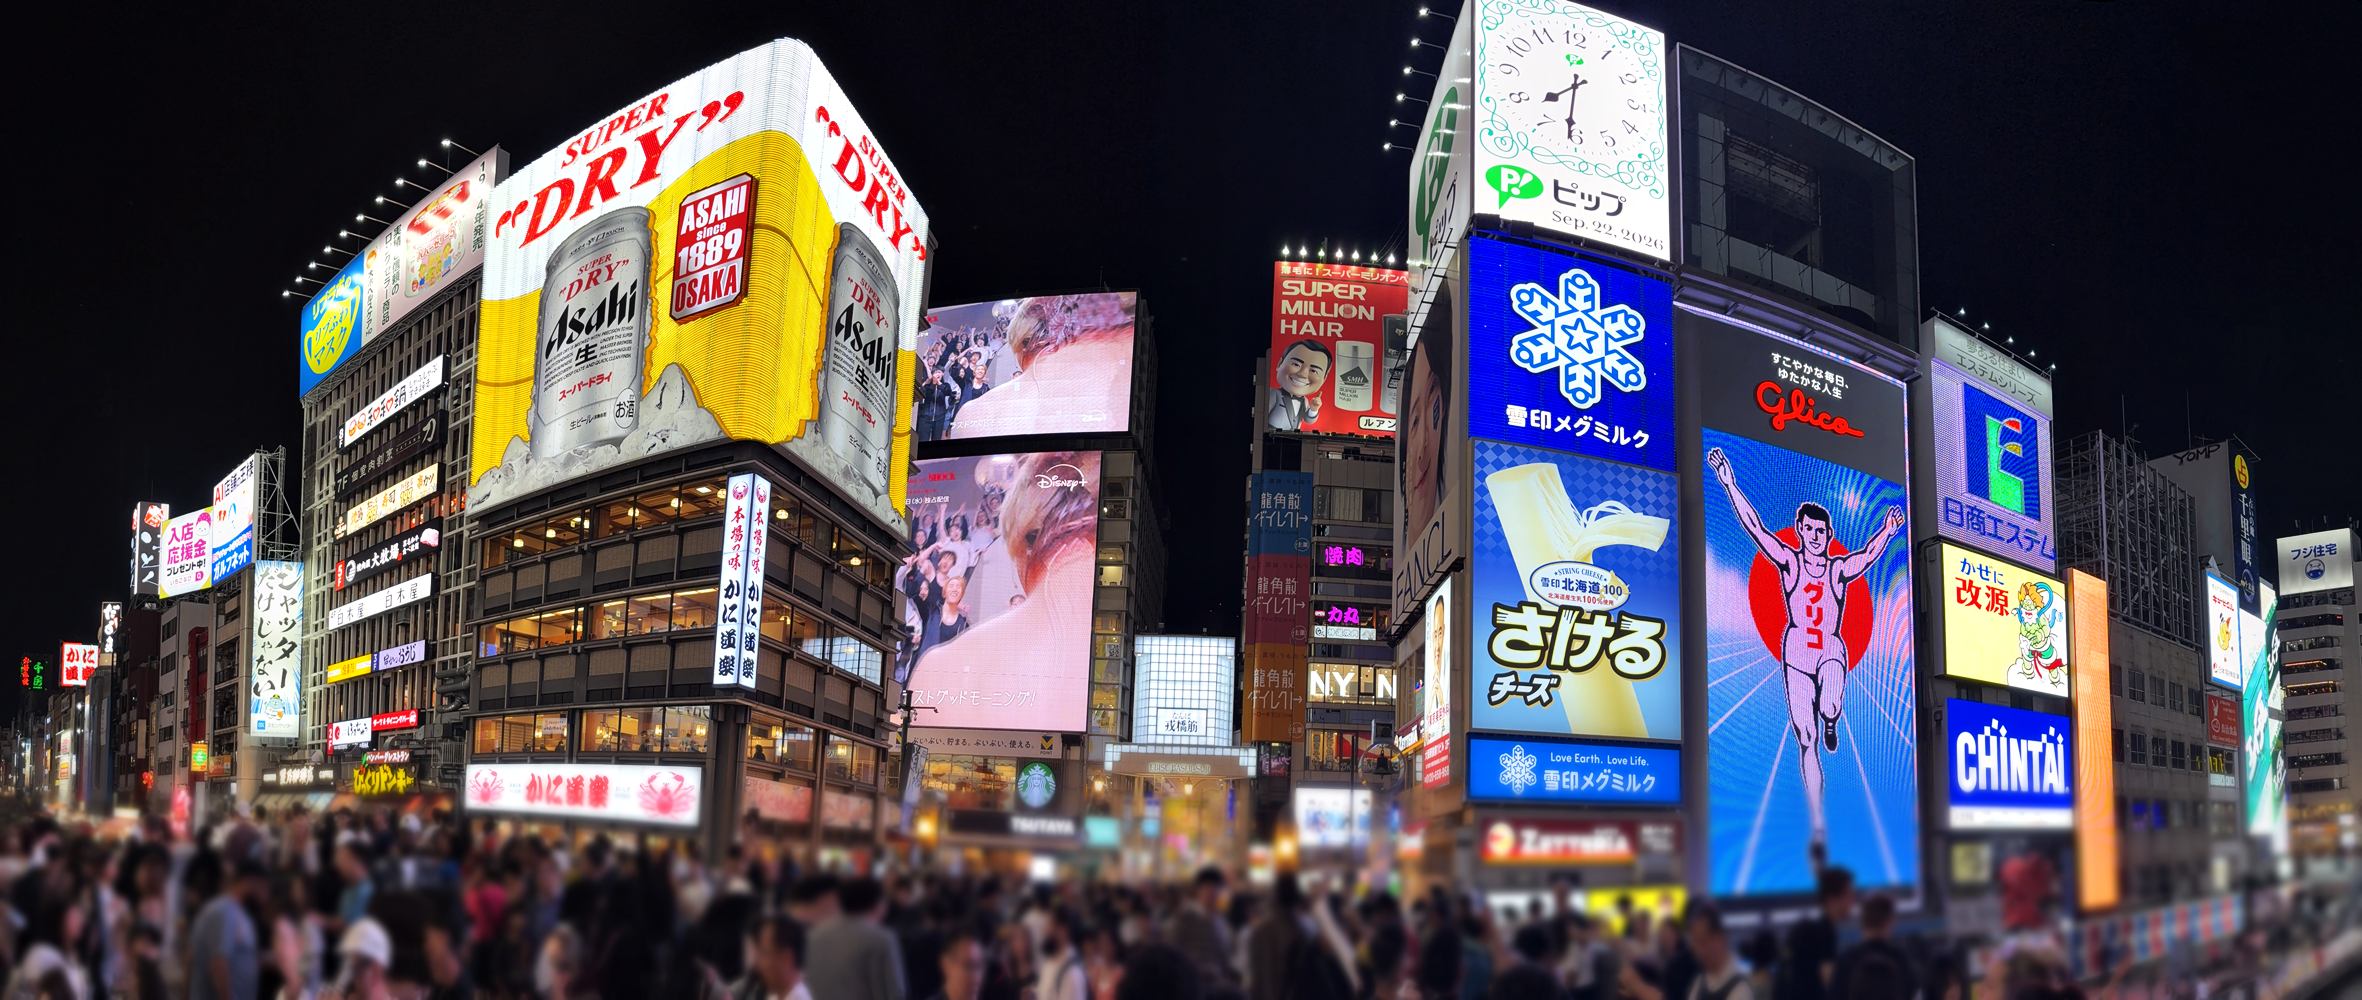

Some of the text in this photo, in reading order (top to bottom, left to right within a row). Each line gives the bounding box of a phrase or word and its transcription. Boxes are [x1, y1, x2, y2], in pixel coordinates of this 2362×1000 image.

[1506, 37, 1531, 57] 10
[1533, 28, 1555, 44] 11
[1563, 30, 1586, 49] 12
[1499, 63, 1520, 77] 9
[1509, 91, 1530, 104] 8
[561, 92, 669, 169] SUPER
[1537, 114, 1556, 127] 7
[1622, 119, 1639, 134] 4
[1569, 128, 1584, 145] 6
[1600, 129, 1616, 148] 5
[859, 134, 906, 208] SUPER
[473, 160, 487, 253] 194年発売
[680, 183, 747, 236] ASAHI
[1553, 178, 1627, 216] ピップ
[696, 221, 726, 242] since
[1552, 209, 1664, 250] Sep. 22, 2026
[577, 253, 612, 276] SUPER
[678, 228, 743, 275] 1889
[675, 264, 738, 313] OSAKA
[1282, 279, 1366, 300] SUPER
[545, 278, 638, 360] Asahi
[1281, 299, 1375, 320] MILLION
[1280, 319, 1344, 337] HAIR
[575, 343, 598, 367] 生
[834, 302, 893, 388] Asahi
[855, 364, 870, 393] 生
[1771, 352, 1849, 389] すこやかな毎日、
[1778, 367, 1843, 399] ゆたかな人生
[1956, 354, 2036, 406] エステムシリーズ
[559, 371, 613, 401] スーパードライ
[615, 400, 635, 418] お酒
[842, 390, 877, 429] スーパードライ
[1755, 380, 1865, 438] Glico
[1505, 404, 1650, 449] 雪印メグミルク
[337, 474, 348, 492] 7F
[1035, 463, 1088, 491] Disney+
[1260, 491, 1301, 510] 龍角散
[167, 522, 194, 545] 入店
[728, 505, 745, 571] 本場の味
[1944, 495, 2057, 561] 日商エステム
[167, 538, 207, 566] 応援金
[751, 508, 764, 575] 本場の味
[2291, 543, 2337, 560] フジ住宅
[167, 558, 206, 577] プレゼント中!
[213, 544, 249, 581] ガルフネット
[1325, 546, 1365, 567] 焼肉
[1394, 510, 1452, 619] FANCL
[1558, 567, 1580, 576] STRING
[1256, 576, 1297, 595] 龍角散
[1955, 577, 2010, 617] 改源
[275, 562, 300, 689] シャッター
[1327, 606, 1359, 624] 力丸
[1803, 581, 1824, 650] グリコ
[252, 566, 275, 697] だけじゃない
[1490, 603, 1665, 678] さける
[66, 647, 95, 664] かに
[1253, 668, 1295, 688] 龍角散
[1489, 672, 1560, 706] チーズ
[1165, 720, 1198, 732] 戎橋筋
[1550, 752, 1649, 766] Love Earth. Love Life.
[1543, 769, 1656, 793] 雪印メグミルク
[1010, 815, 1074, 835] TSUTAYA
